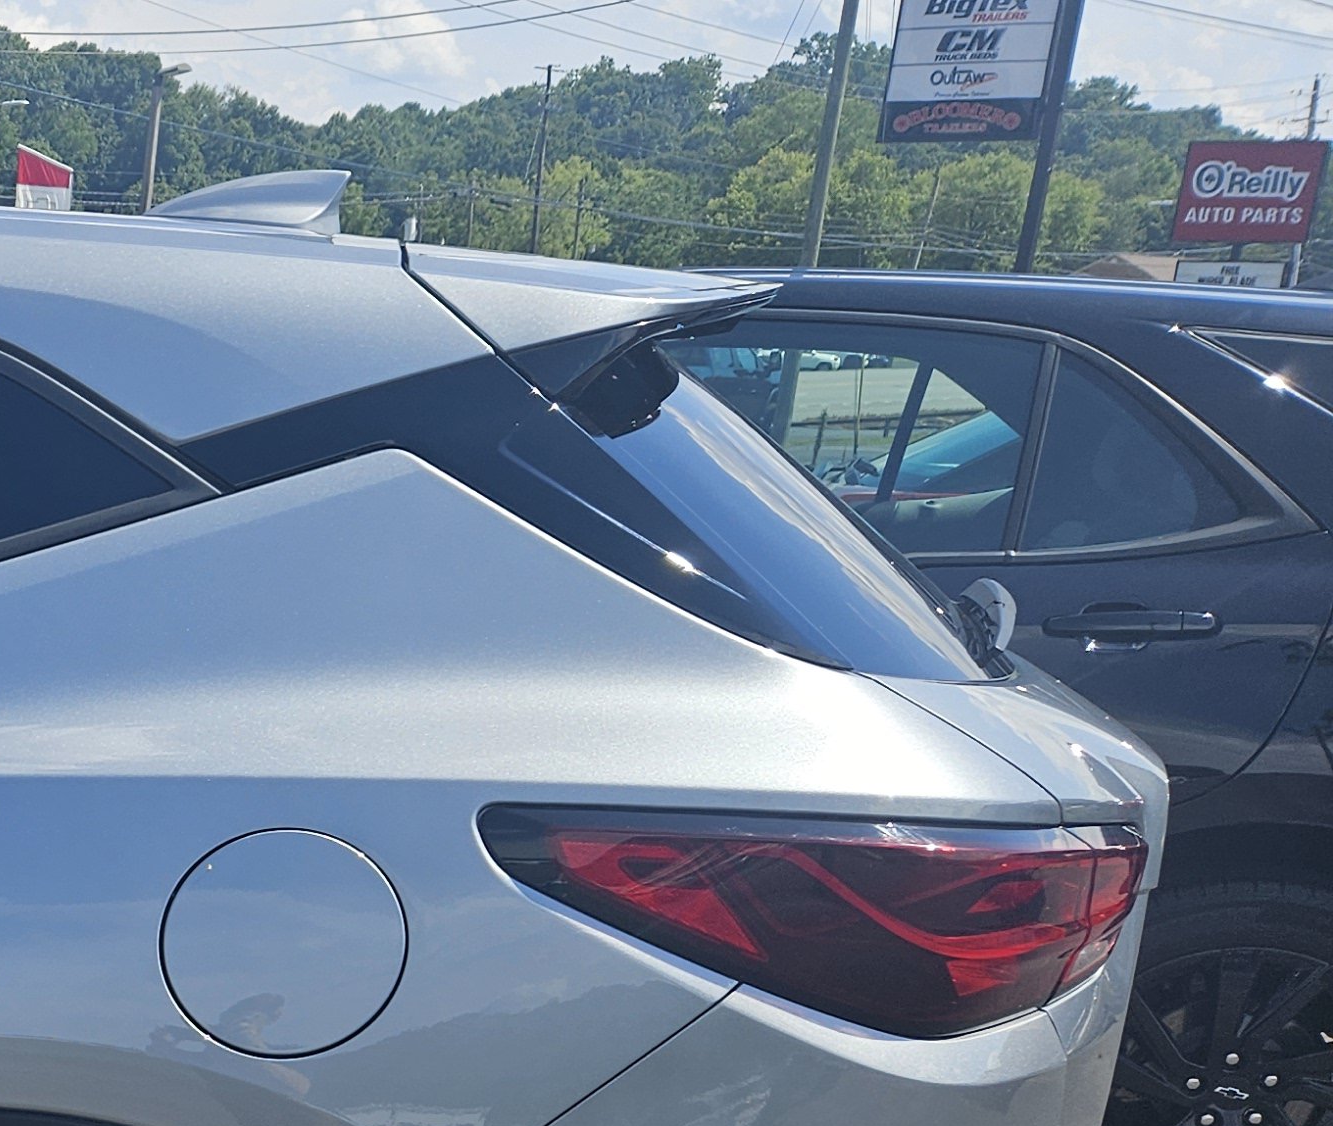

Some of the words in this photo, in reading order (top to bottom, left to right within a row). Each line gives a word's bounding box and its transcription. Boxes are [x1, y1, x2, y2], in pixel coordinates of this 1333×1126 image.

[972, 11, 1029, 22] TRAILERS
[936, 27, 1007, 52] CM
[934, 53, 967, 61] TRUCK
[969, 52, 998, 60] BEDS
[1194, 162, 1307, 200] O'Reilly
[1184, 207, 1235, 223] AUTO
[1240, 206, 1304, 224] PARTS
